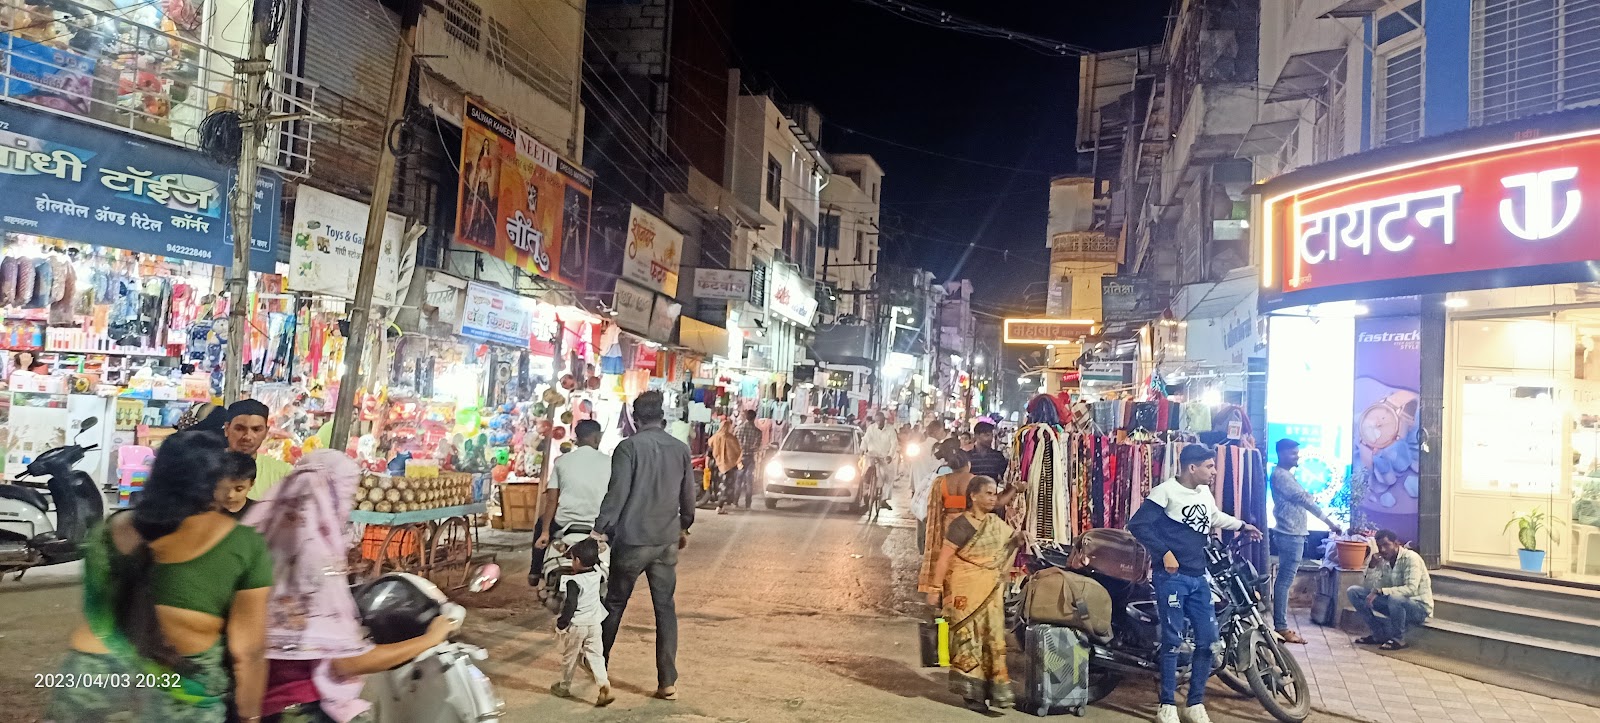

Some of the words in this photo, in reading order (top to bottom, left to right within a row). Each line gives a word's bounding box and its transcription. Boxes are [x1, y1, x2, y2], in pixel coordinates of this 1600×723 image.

[471, 107, 493, 127] SALWAR
[519, 132, 555, 168] NEETU
[35, 193, 90, 219] होलसेल
[131, 211, 163, 233] रिटेल
[171, 213, 210, 234] कॉर्नर
[325, 224, 344, 241] Toys
[344, 230, 352, 241] &
[1299, 185, 1463, 264] टायटन
[1103, 281, 1135, 296] प्रतिक्षा
[1358, 329, 1421, 343] fastrack
